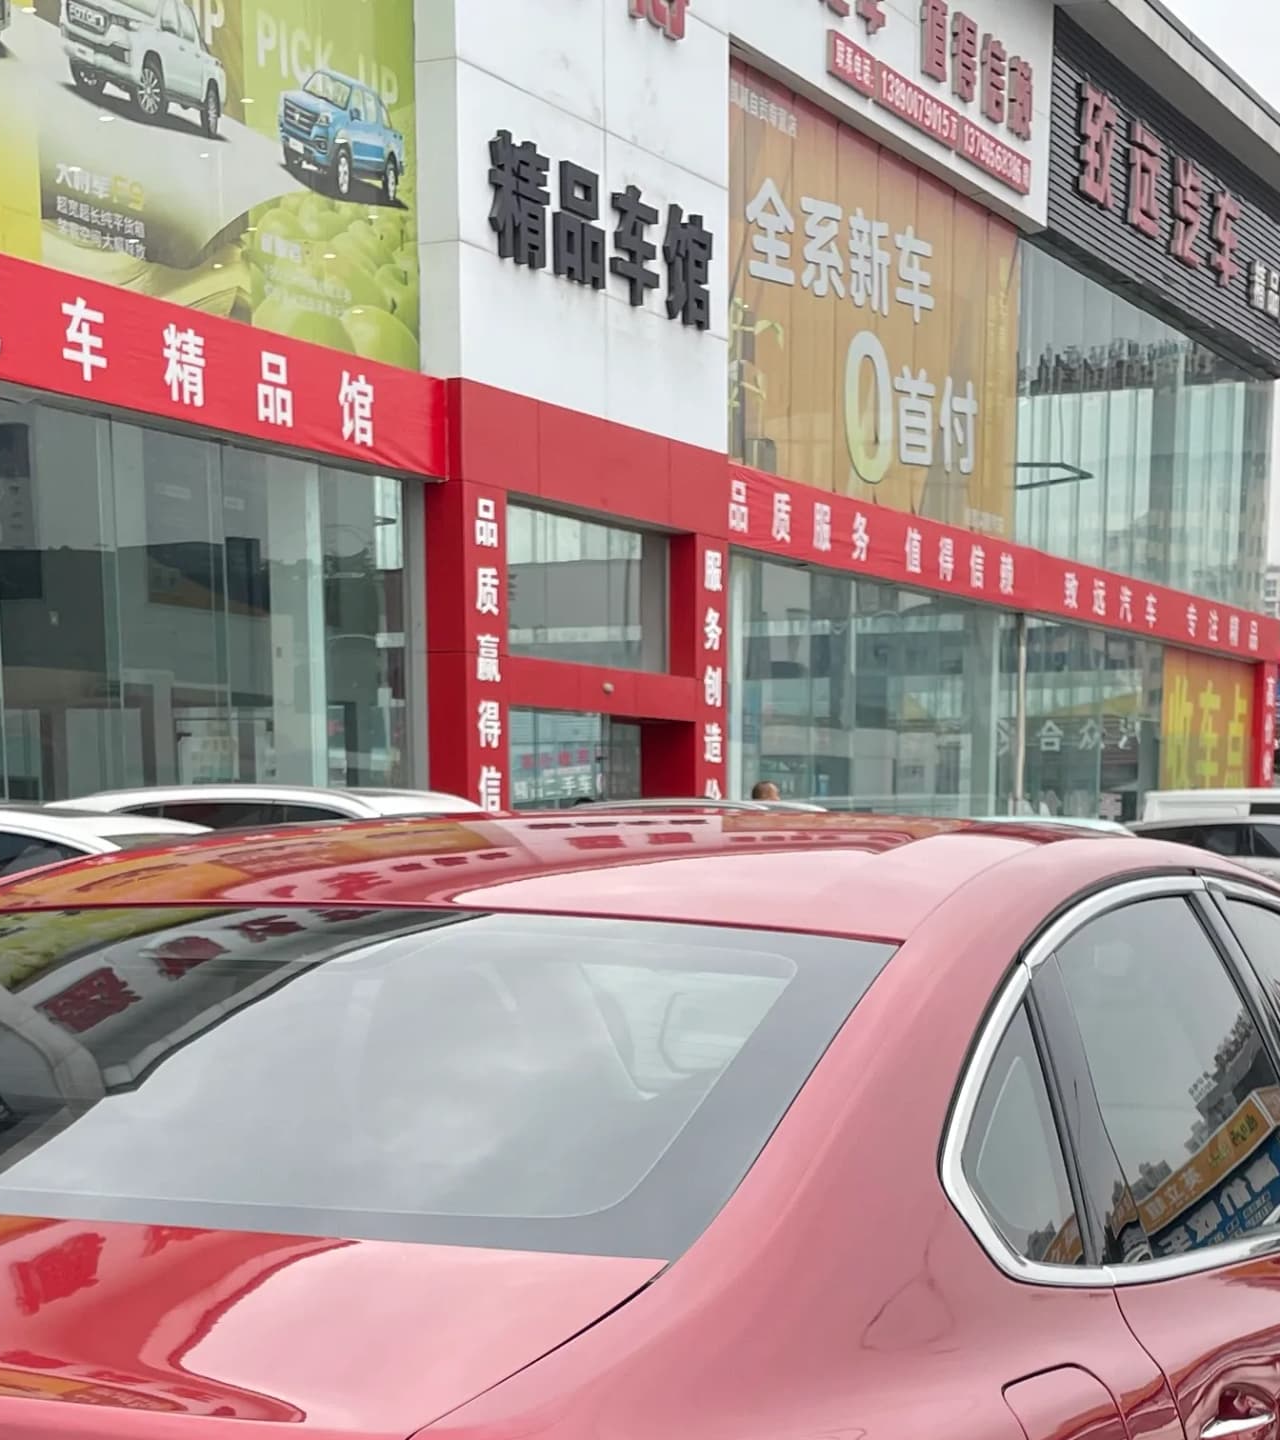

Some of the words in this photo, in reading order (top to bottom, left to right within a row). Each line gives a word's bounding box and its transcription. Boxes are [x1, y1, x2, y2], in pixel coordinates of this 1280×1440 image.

[922, 0, 1032, 140] 值得信赖
[488, 130, 713, 331] 精品车馆
[745, 177, 935, 324] 全系新车
[1078, 80, 1242, 288] 致远汽车
[845, 331, 978, 484] 0首付
[728, 480, 872, 562] 品质服务
[905, 526, 1015, 596] 值得信赖
[1063, 572, 1158, 629] 致远汽车
[1186, 602, 1259, 651] 专注精品
[476, 497, 502, 811] 品质赢得信
